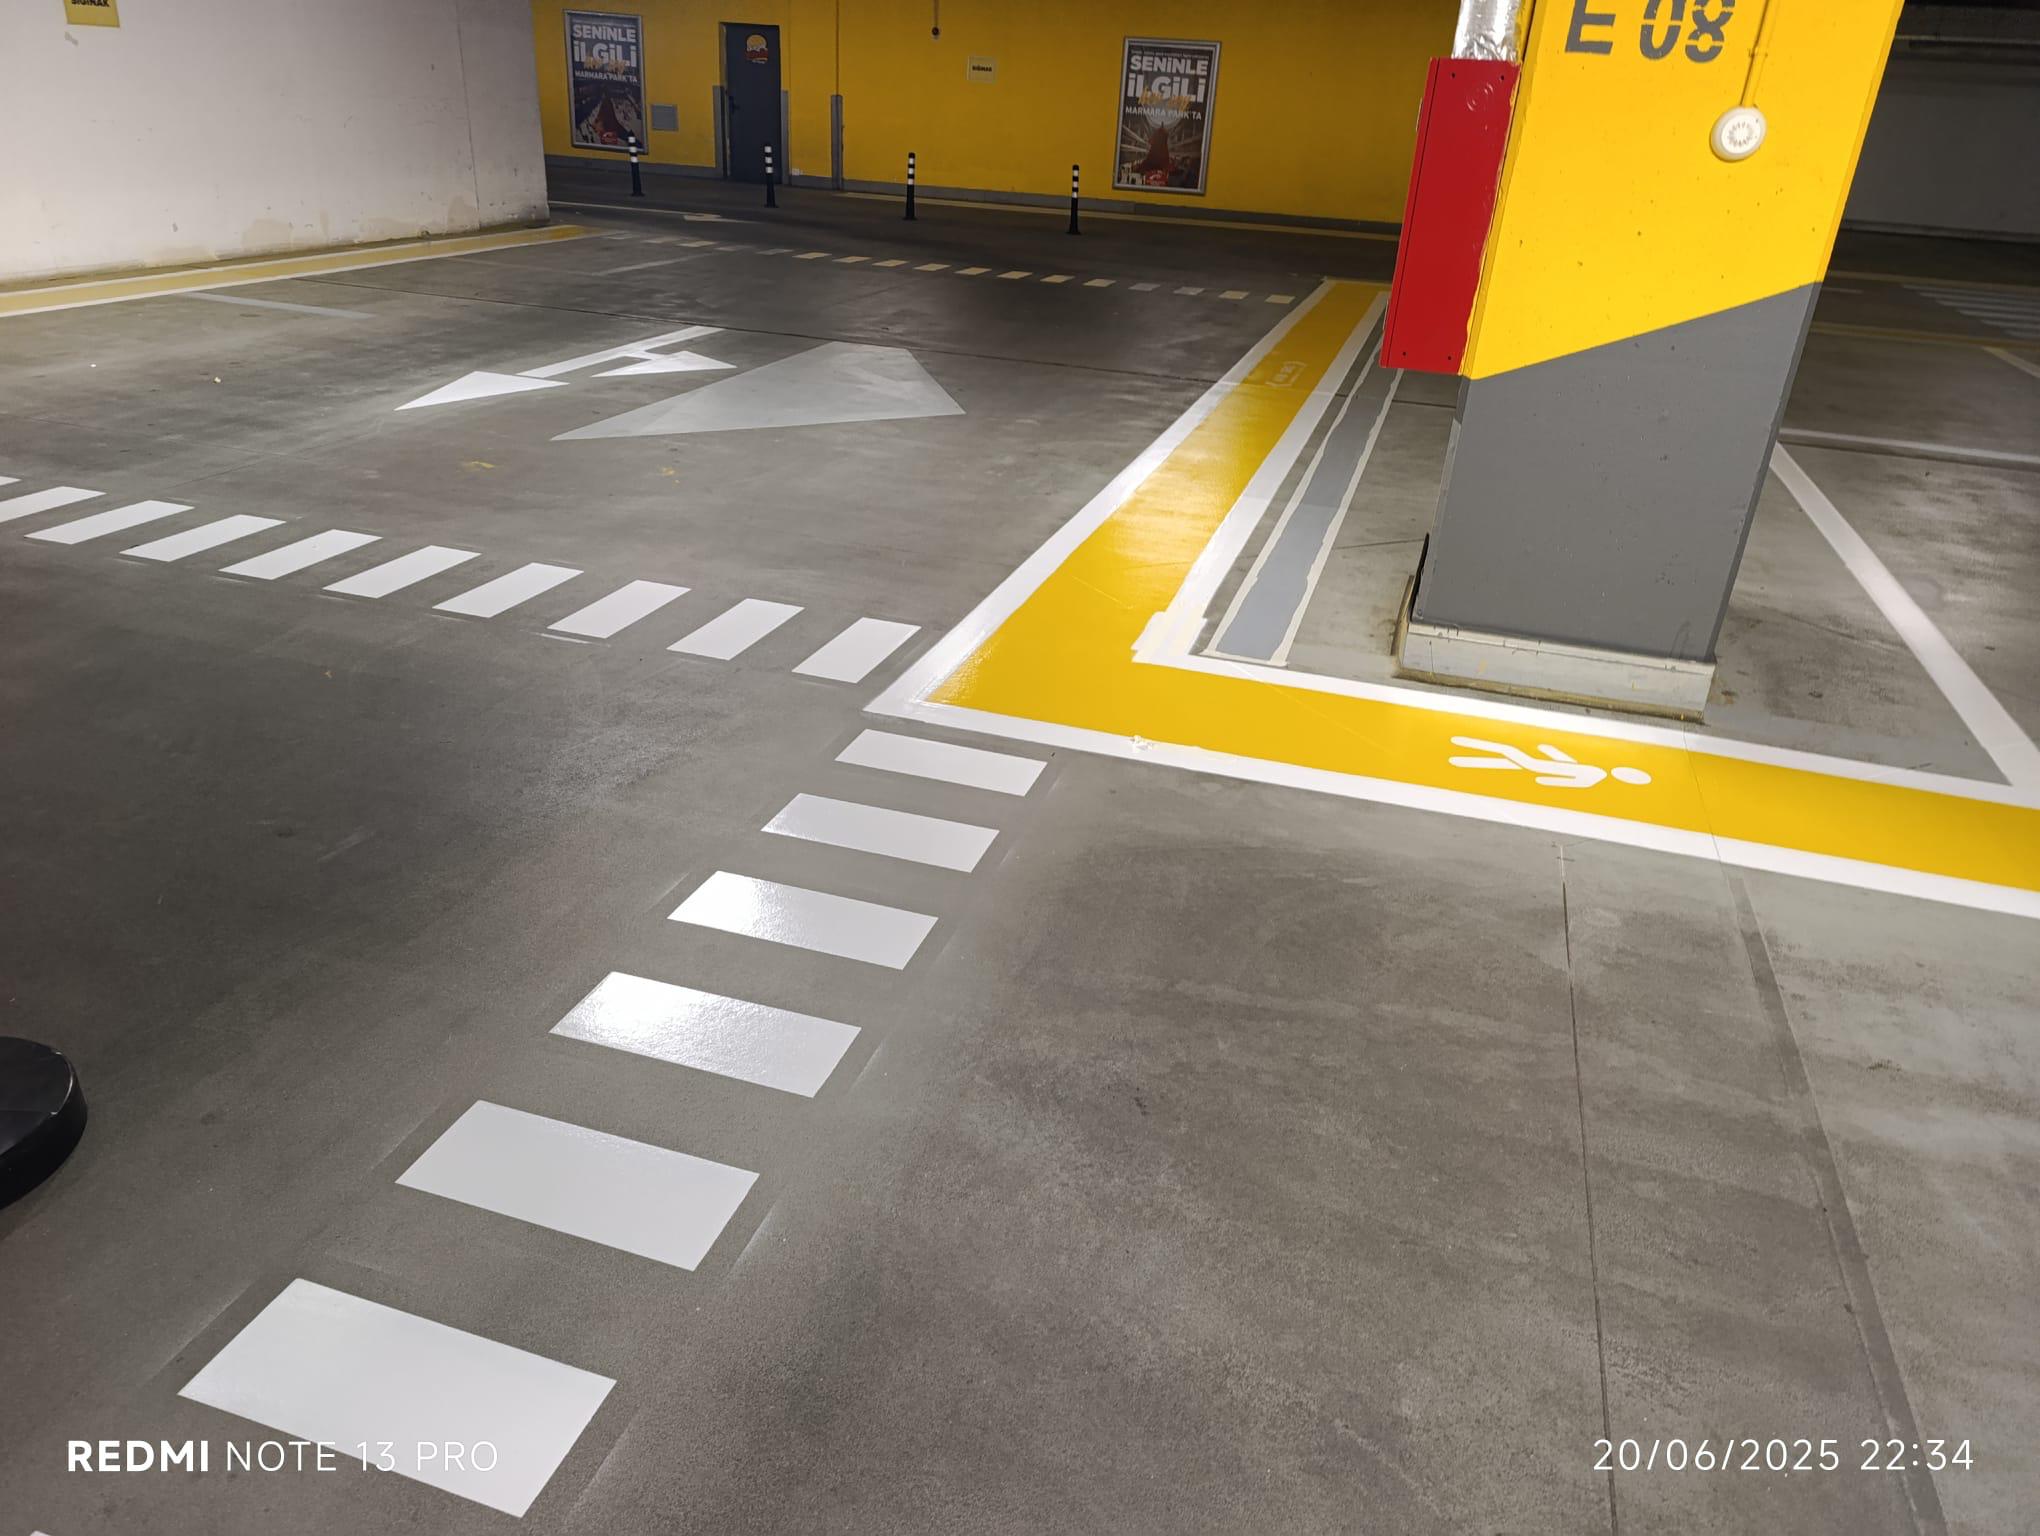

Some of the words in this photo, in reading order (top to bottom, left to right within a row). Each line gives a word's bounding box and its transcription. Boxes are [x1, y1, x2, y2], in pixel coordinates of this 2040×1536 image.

[1565, 0, 1616, 56] E
[1640, 0, 1736, 63] 08
[1125, 106, 1166, 116] MARMARA
